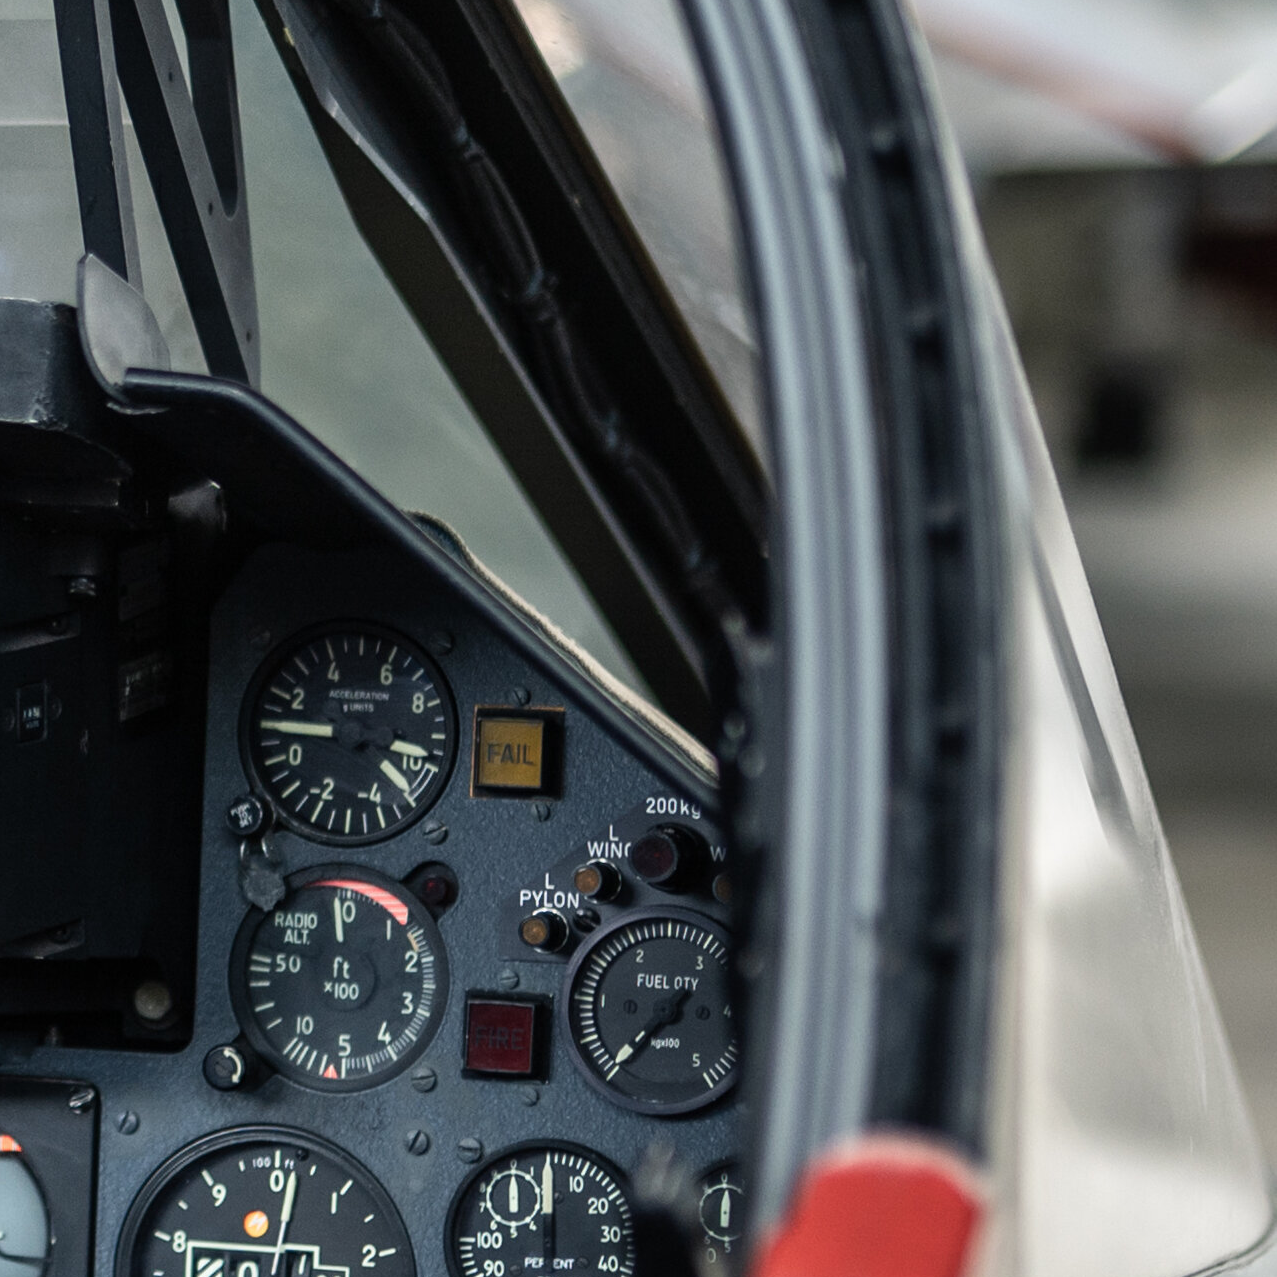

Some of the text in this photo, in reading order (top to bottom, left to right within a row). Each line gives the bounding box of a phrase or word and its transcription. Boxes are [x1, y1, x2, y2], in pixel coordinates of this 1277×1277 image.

[327, 663, 340, 682] 4
[381, 666, 393, 685] 6
[292, 690, 304, 709] 2
[329, 690, 390, 701] ACCELERATION
[412, 694, 424, 712] 8
[350, 704, 374, 712] UNITS
[289, 746, 302, 765] 0
[486, 742, 534, 765] FAIL
[310, 779, 334, 800] -2
[357, 783, 382, 804] -4
[609, 825, 618, 841] L
[546, 873, 555, 889] L
[520, 889, 579, 908] PYLON
[274, 913, 318, 929] RADIO
[342, 902, 356, 923] 0
[284, 929, 310, 945] ALT.
[275, 955, 301, 972] 50
[405, 953, 418, 972] 2
[636, 947, 644, 963] 2
[696, 956, 703, 970] 3
[333, 958, 350, 979] ft
[637, 973, 669, 989] FUEL
[402, 993, 414, 1014] 3
[296, 1016, 313, 1035] 10
[378, 1023, 392, 1043] 4
[339, 1036, 351, 1057] 5
[474, 1027, 525, 1049] FIRE
[693, 1053, 700, 1067] 5
[252, 1157, 295, 1169] 100 ft
[270, 1169, 284, 1192] 0
[569, 1177, 583, 1192] 10
[212, 1184, 227, 1207] 9
[588, 1198, 609, 1214] 20
[172, 1230, 186, 1253] 8
[477, 1232, 502, 1248] 100
[600, 1227, 620, 1243] 30
[362, 1245, 375, 1267] 2
[598, 1256, 618, 1272] 40
[484, 1261, 504, 1277] 90
